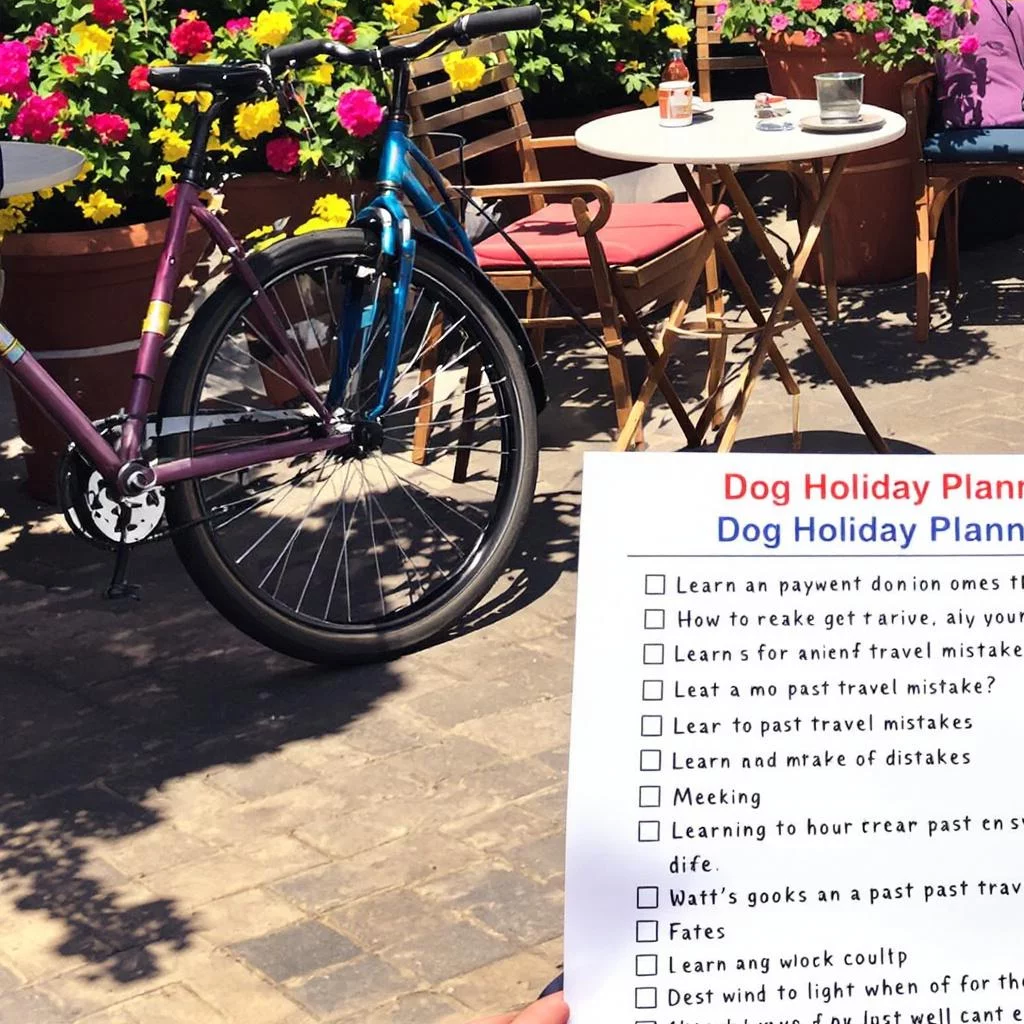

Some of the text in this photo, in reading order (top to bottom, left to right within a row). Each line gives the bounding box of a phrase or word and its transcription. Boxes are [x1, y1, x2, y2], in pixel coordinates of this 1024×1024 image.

[724, 472, 790, 507] Dog
[804, 473, 931, 506] Holiday
[717, 516, 781, 550] Dog
[794, 515, 917, 550] Holiday
[676, 575, 736, 595] Learn
[745, 580, 768, 593] an
[950, 578, 1000, 591] omes
[677, 609, 721, 629] How
[729, 611, 749, 627] to
[757, 609, 815, 627] reake
[824, 610, 856, 631] get
[674, 644, 732, 663] Learn
[757, 643, 789, 661] for
[869, 641, 931, 660] travel
[674, 675, 997, 701] Leat a mo past travel mistake?
[673, 712, 973, 738] Lear to past travel mistakes
[672, 751, 731, 771] Learn
[855, 749, 877, 767] of
[885, 747, 971, 766] distakes
[672, 786, 761, 810] Meeking
[671, 821, 766, 842] Learning
[775, 820, 797, 836] to
[807, 817, 853, 836] hour
[927, 815, 972, 838] past
[747, 885, 808, 908] gooks
[817, 889, 841, 903] an
[850, 888, 861, 901] a
[869, 882, 915, 905] past
[923, 880, 969, 903] past
[669, 922, 725, 941] Fates
[736, 957, 770, 975] ang
[667, 988, 715, 1007] Dest
[722, 983, 766, 1004] wind
[776, 984, 798, 1001] to
[807, 981, 855, 1004] light
[864, 978, 918, 997] when
[929, 974, 952, 994] of
[960, 971, 991, 993] for
[910, 1007, 951, 1024] well
[960, 1005, 1004, 1024] cant
